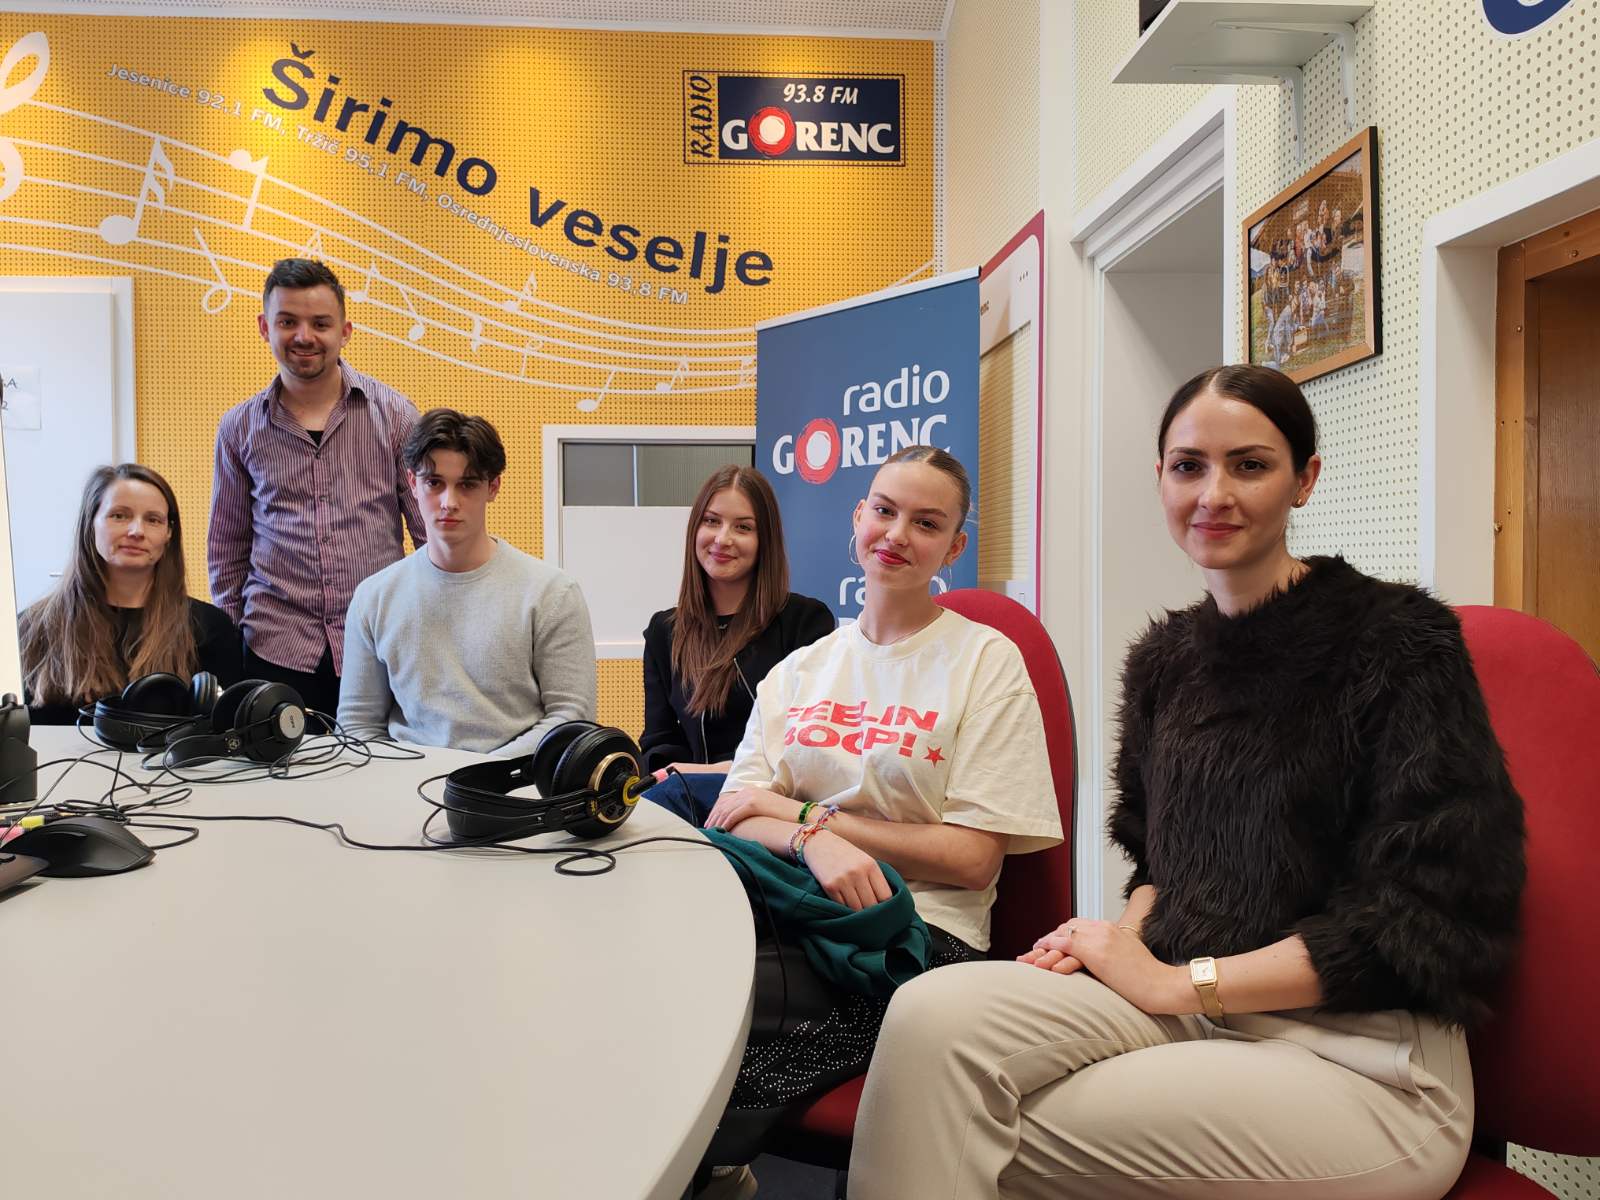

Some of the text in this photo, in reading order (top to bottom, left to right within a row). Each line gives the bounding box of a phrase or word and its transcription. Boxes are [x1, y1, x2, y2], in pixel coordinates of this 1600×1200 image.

[690, 75, 713, 158] RADIO
[783, 83, 859, 105] 93.8 FM
[721, 106, 895, 157] GORENC
[107, 63, 689, 305] Jesenice 92,1 FM, Tržič 95,1 FM, Osrednjeslovenska 93,8 FM
[263, 42, 775, 294] Širimo veselje
[843, 364, 950, 416] radio
[772, 414, 951, 485] GORENC
